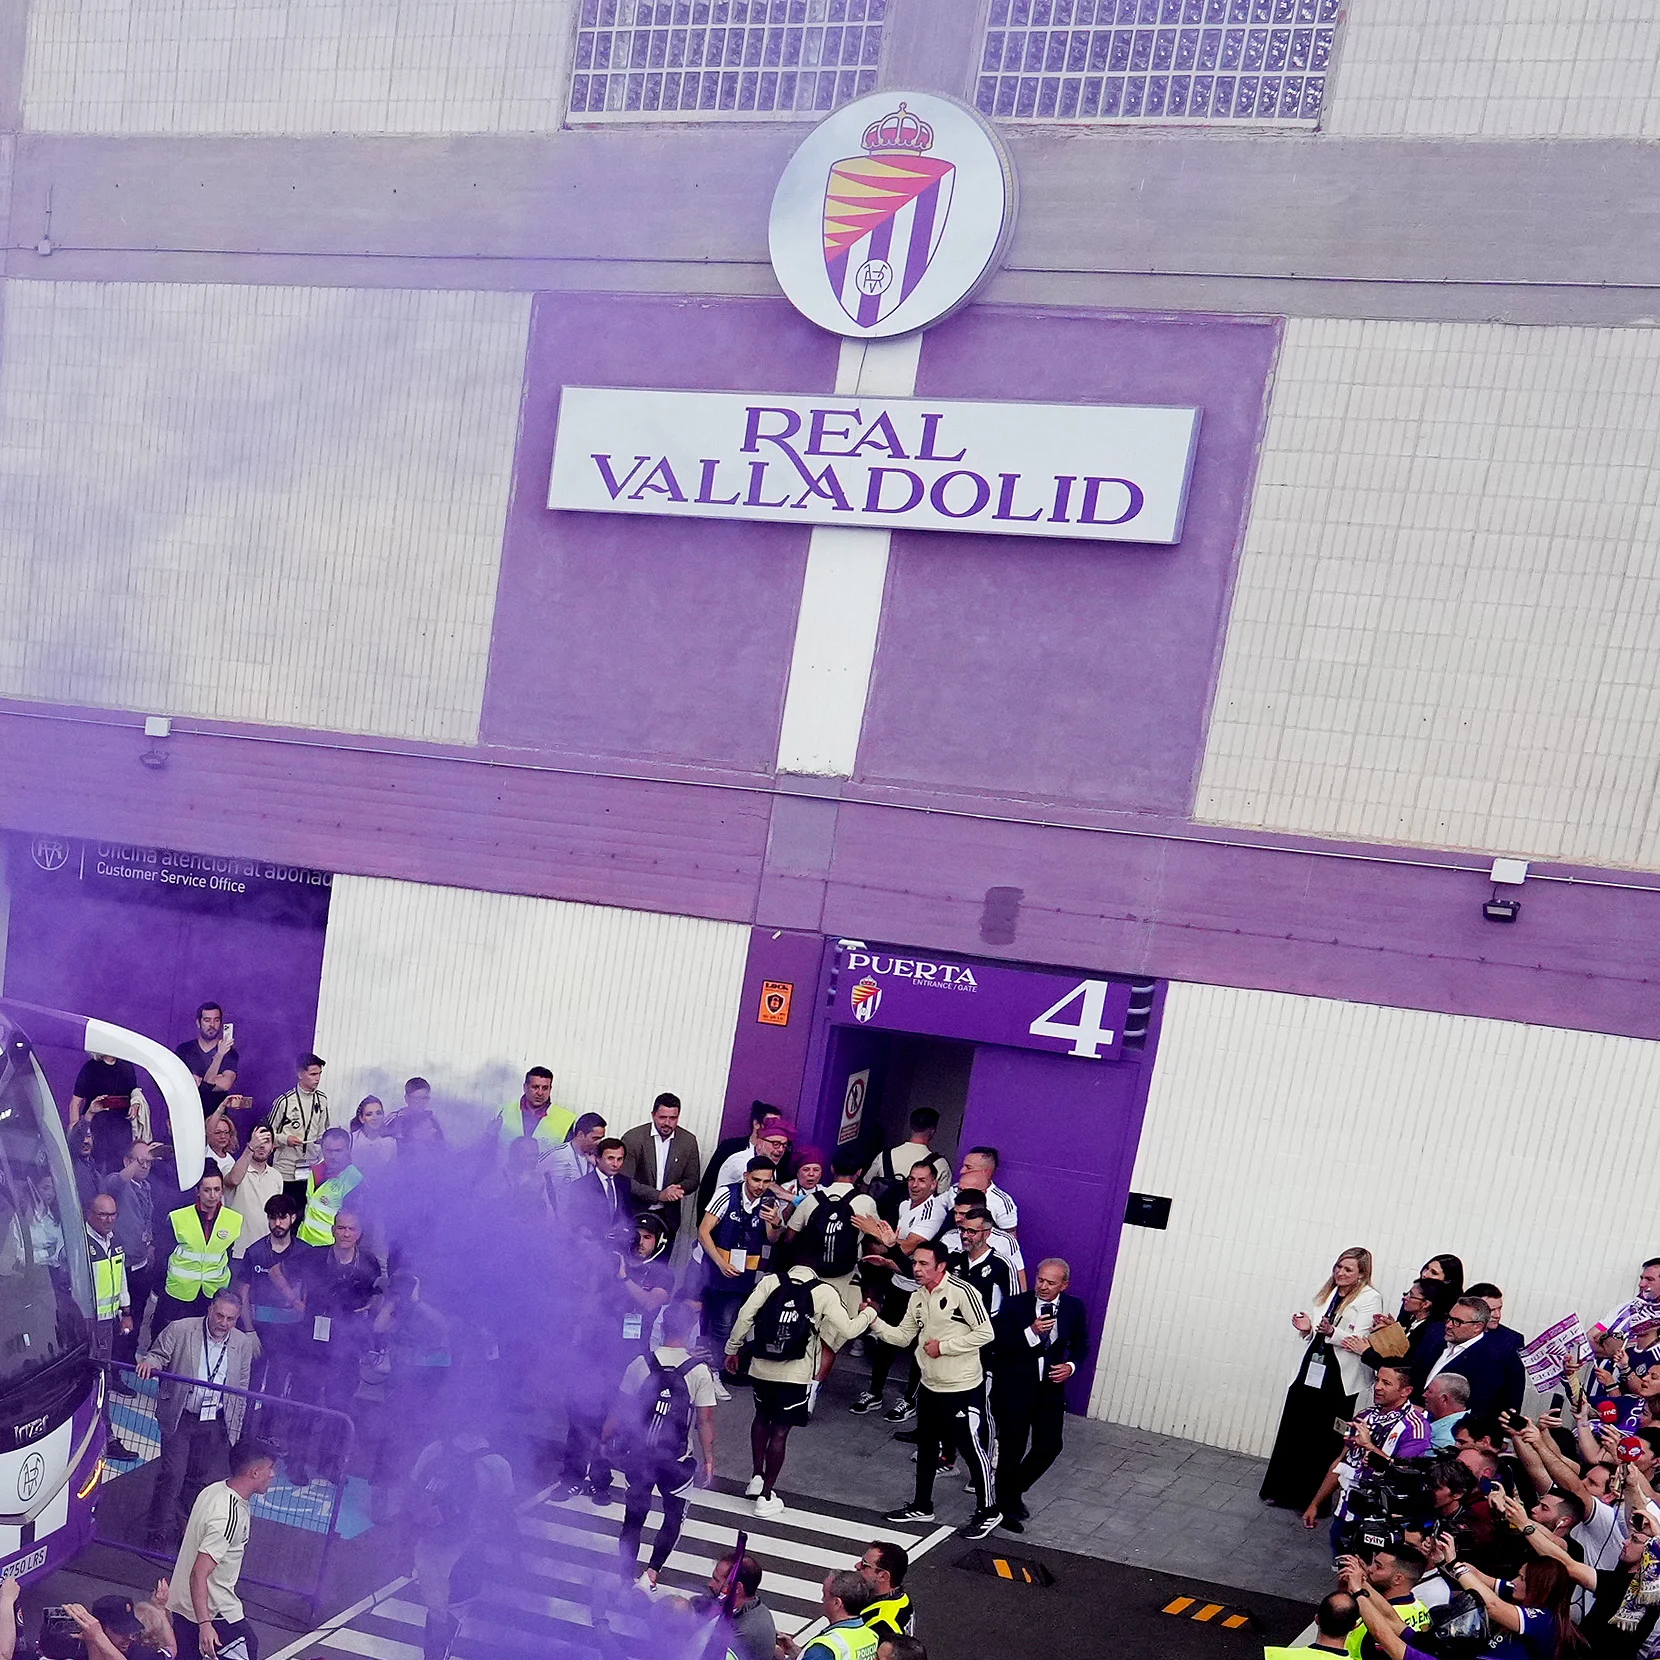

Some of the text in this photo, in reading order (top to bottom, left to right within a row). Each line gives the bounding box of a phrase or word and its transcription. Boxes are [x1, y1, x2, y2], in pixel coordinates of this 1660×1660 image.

[740, 407, 967, 462] REAL
[590, 454, 1145, 526] VALLADOLID
[97, 862, 246, 894] Customer Service Office
[847, 953, 1114, 1059] PUERTA 4
